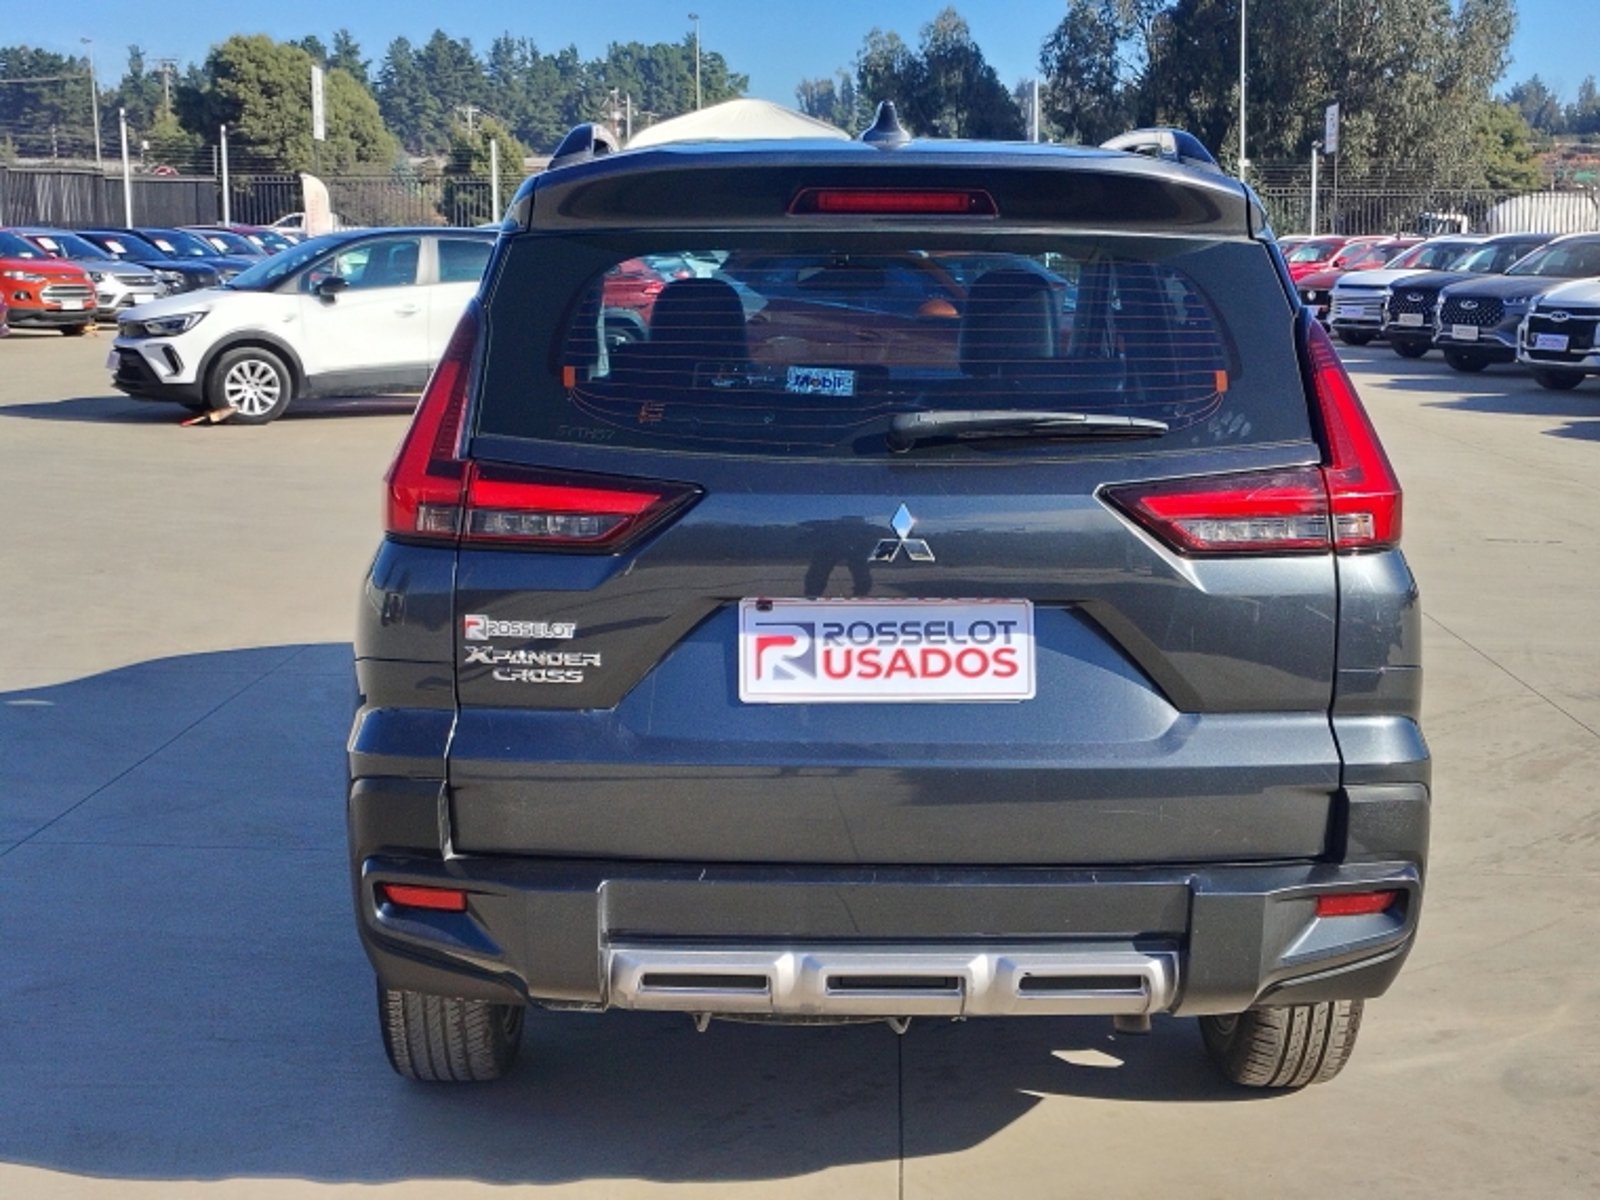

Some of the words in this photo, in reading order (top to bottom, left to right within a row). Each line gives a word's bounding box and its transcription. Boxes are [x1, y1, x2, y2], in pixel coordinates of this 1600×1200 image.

[487, 620, 575, 638] ROSSELOT
[822, 621, 1018, 646] ROSSELOT
[464, 646, 602, 667] XPANDER
[822, 648, 1018, 679] USADOS
[492, 668, 584, 683] CROSS
